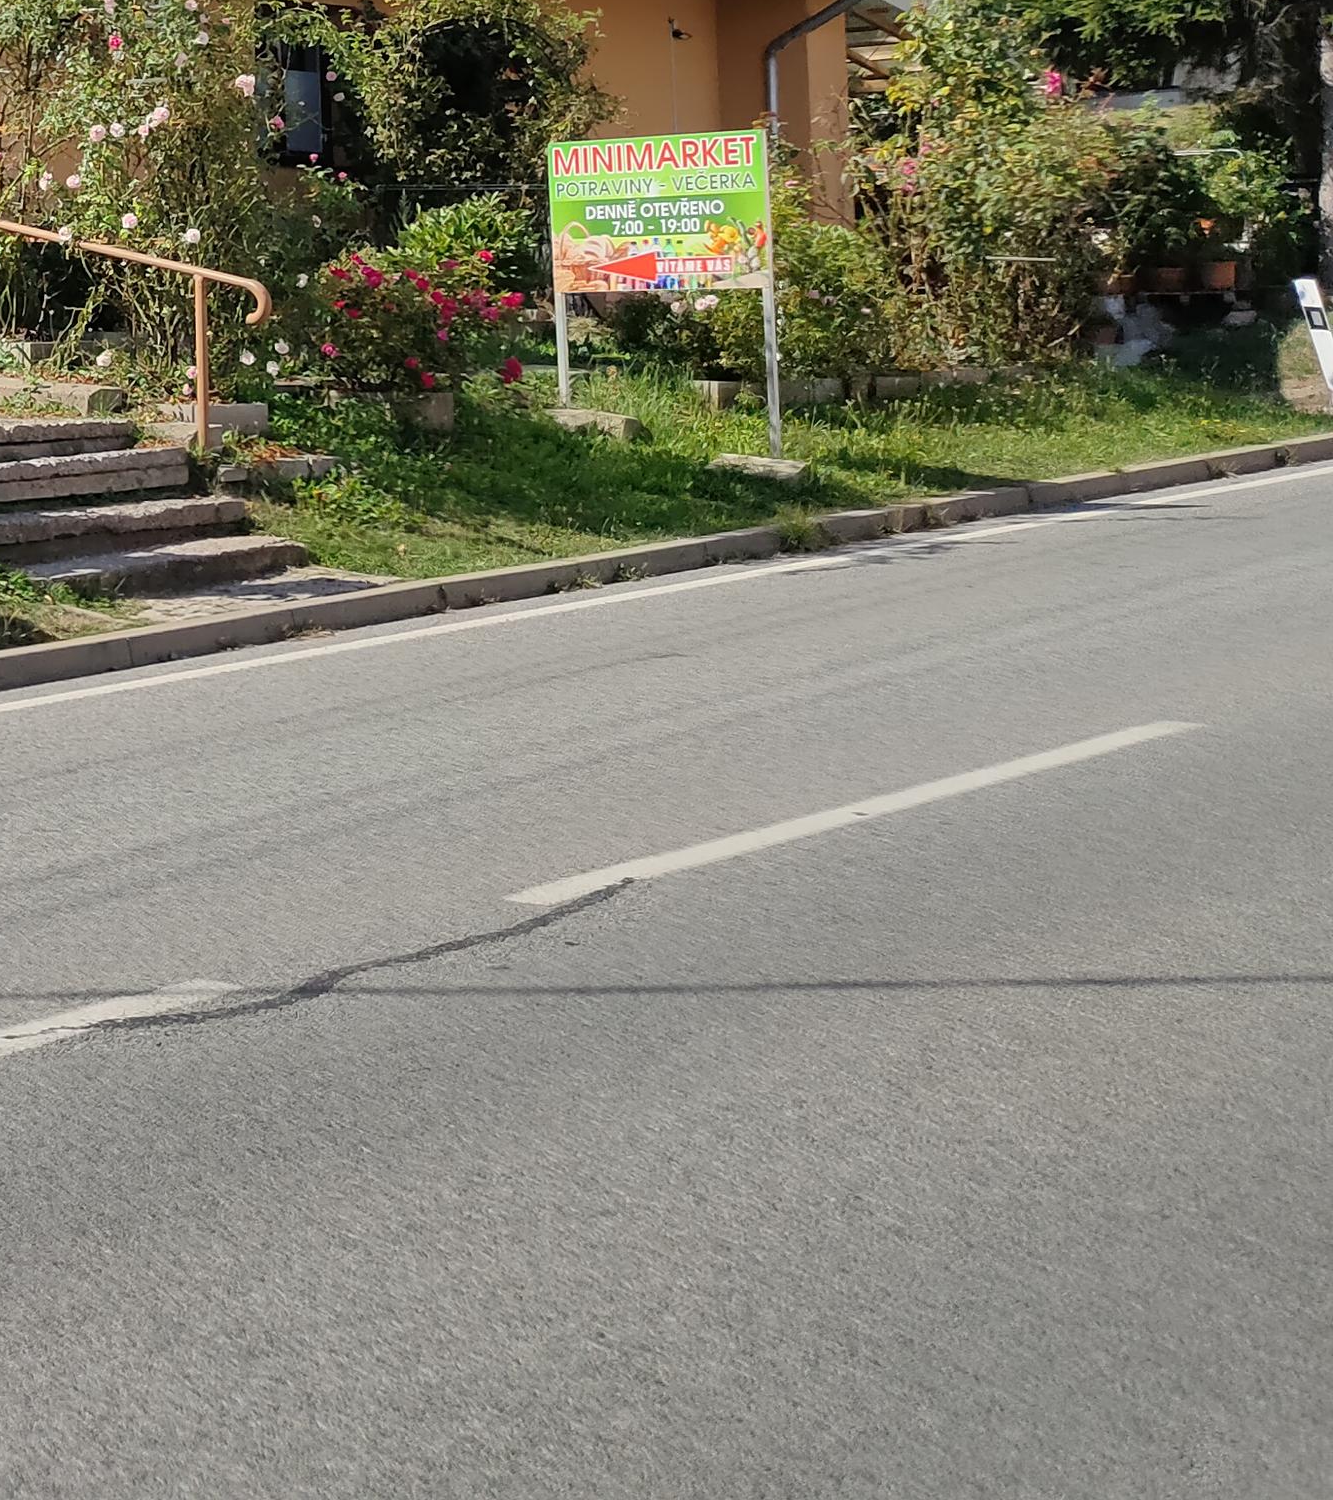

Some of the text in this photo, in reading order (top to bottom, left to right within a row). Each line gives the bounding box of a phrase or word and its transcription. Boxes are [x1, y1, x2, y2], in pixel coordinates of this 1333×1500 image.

[553, 136, 756, 177] MINIMARKET
[556, 178, 655, 198] POTRAVINY
[672, 171, 756, 192] VEČERKA
[585, 198, 725, 220] DENNĚ OTEVŘENO
[612, 220, 644, 235] 7:00
[660, 218, 701, 233] 19:00
